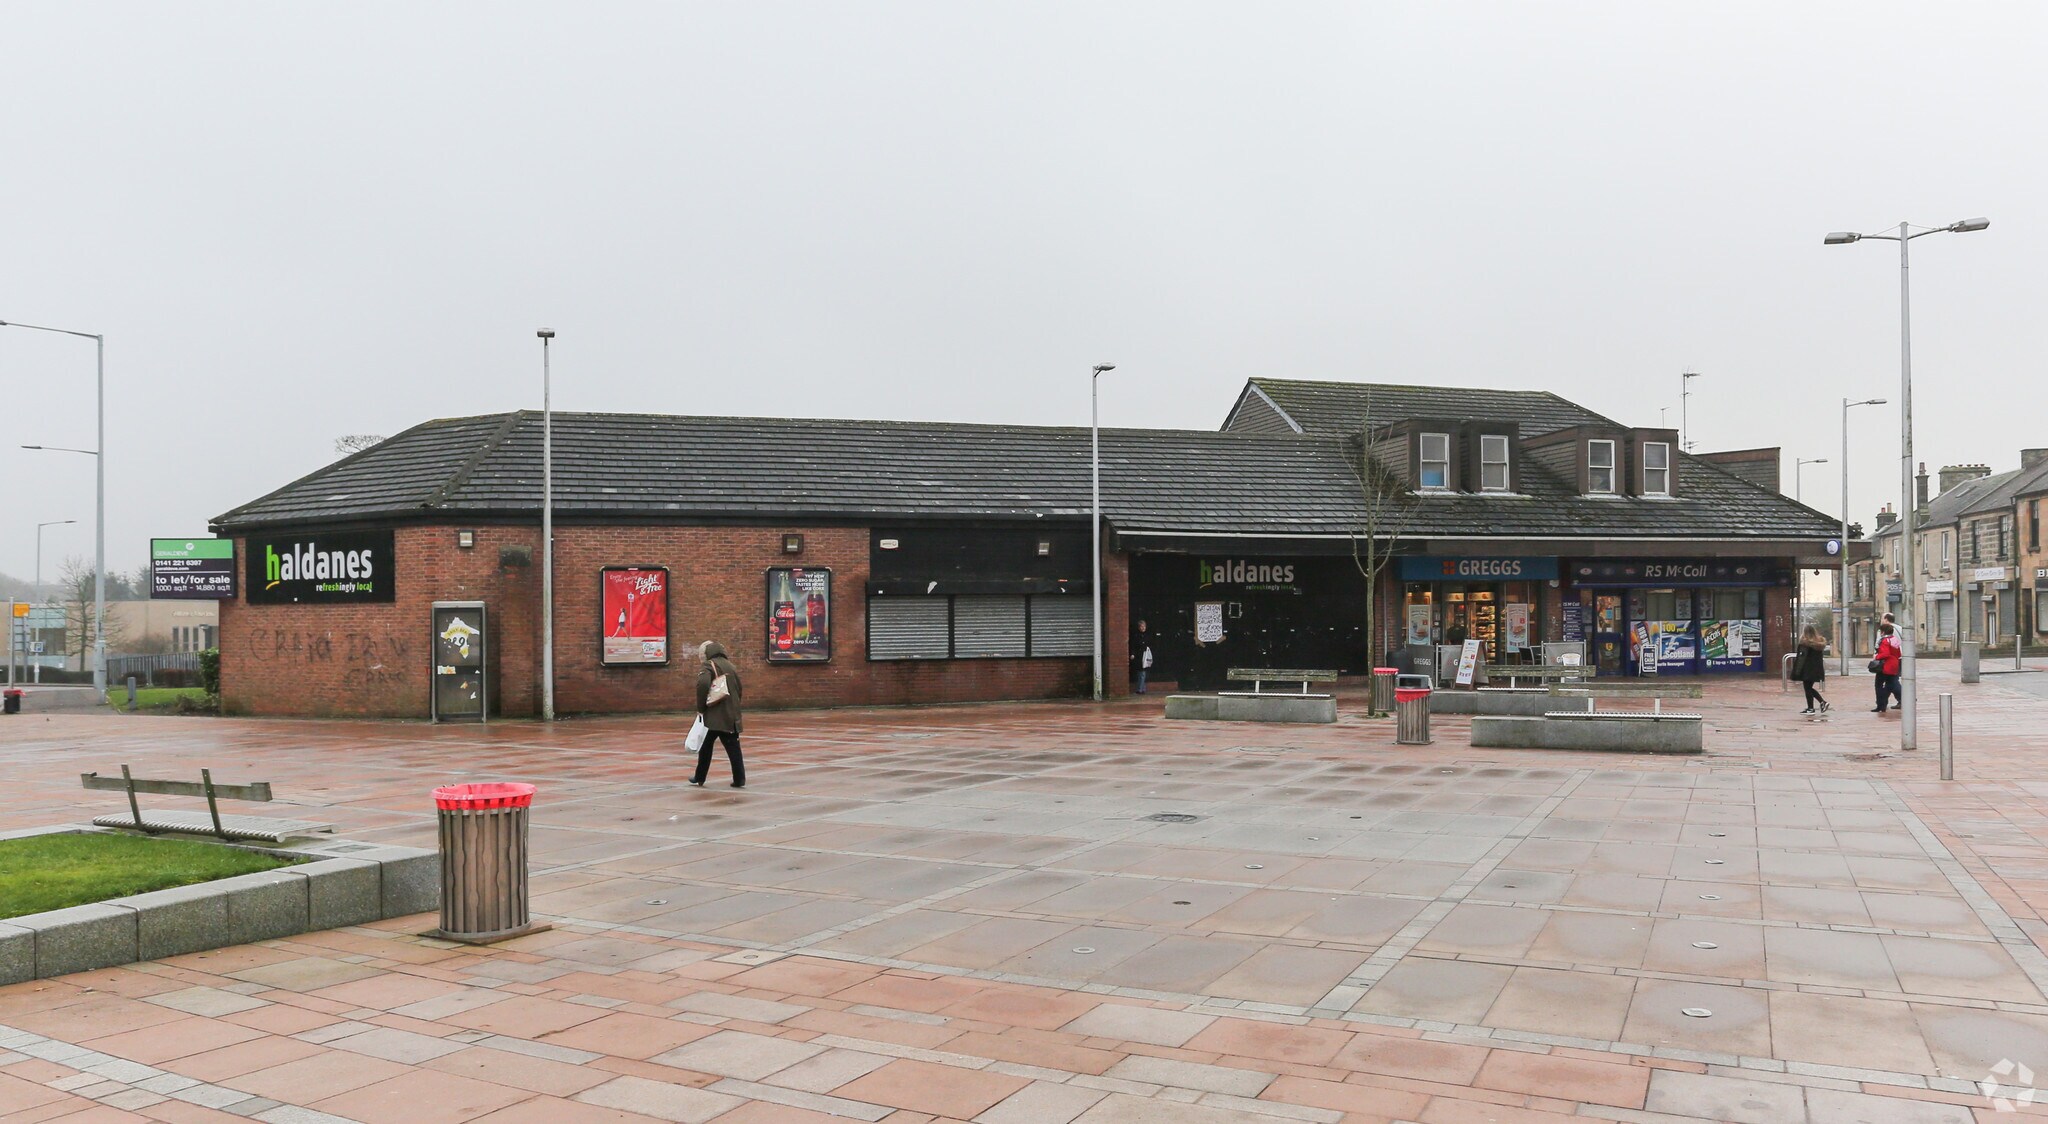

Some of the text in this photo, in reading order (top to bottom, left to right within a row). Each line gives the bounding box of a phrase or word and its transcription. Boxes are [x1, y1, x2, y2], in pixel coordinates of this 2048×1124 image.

[266, 542, 373, 580] haldanes
[1200, 559, 1294, 583] haldanes
[1459, 560, 1522, 575] GREGGS
[1645, 565, 1662, 577] RS
[155, 574, 231, 584] to let/for sale
[635, 574, 659, 590] Light
[316, 581, 373, 592] refreshingly local
[1663, 623, 1676, 632] 100
[1666, 650, 1695, 658] Scotland
[1413, 657, 1432, 666] GREGGS
